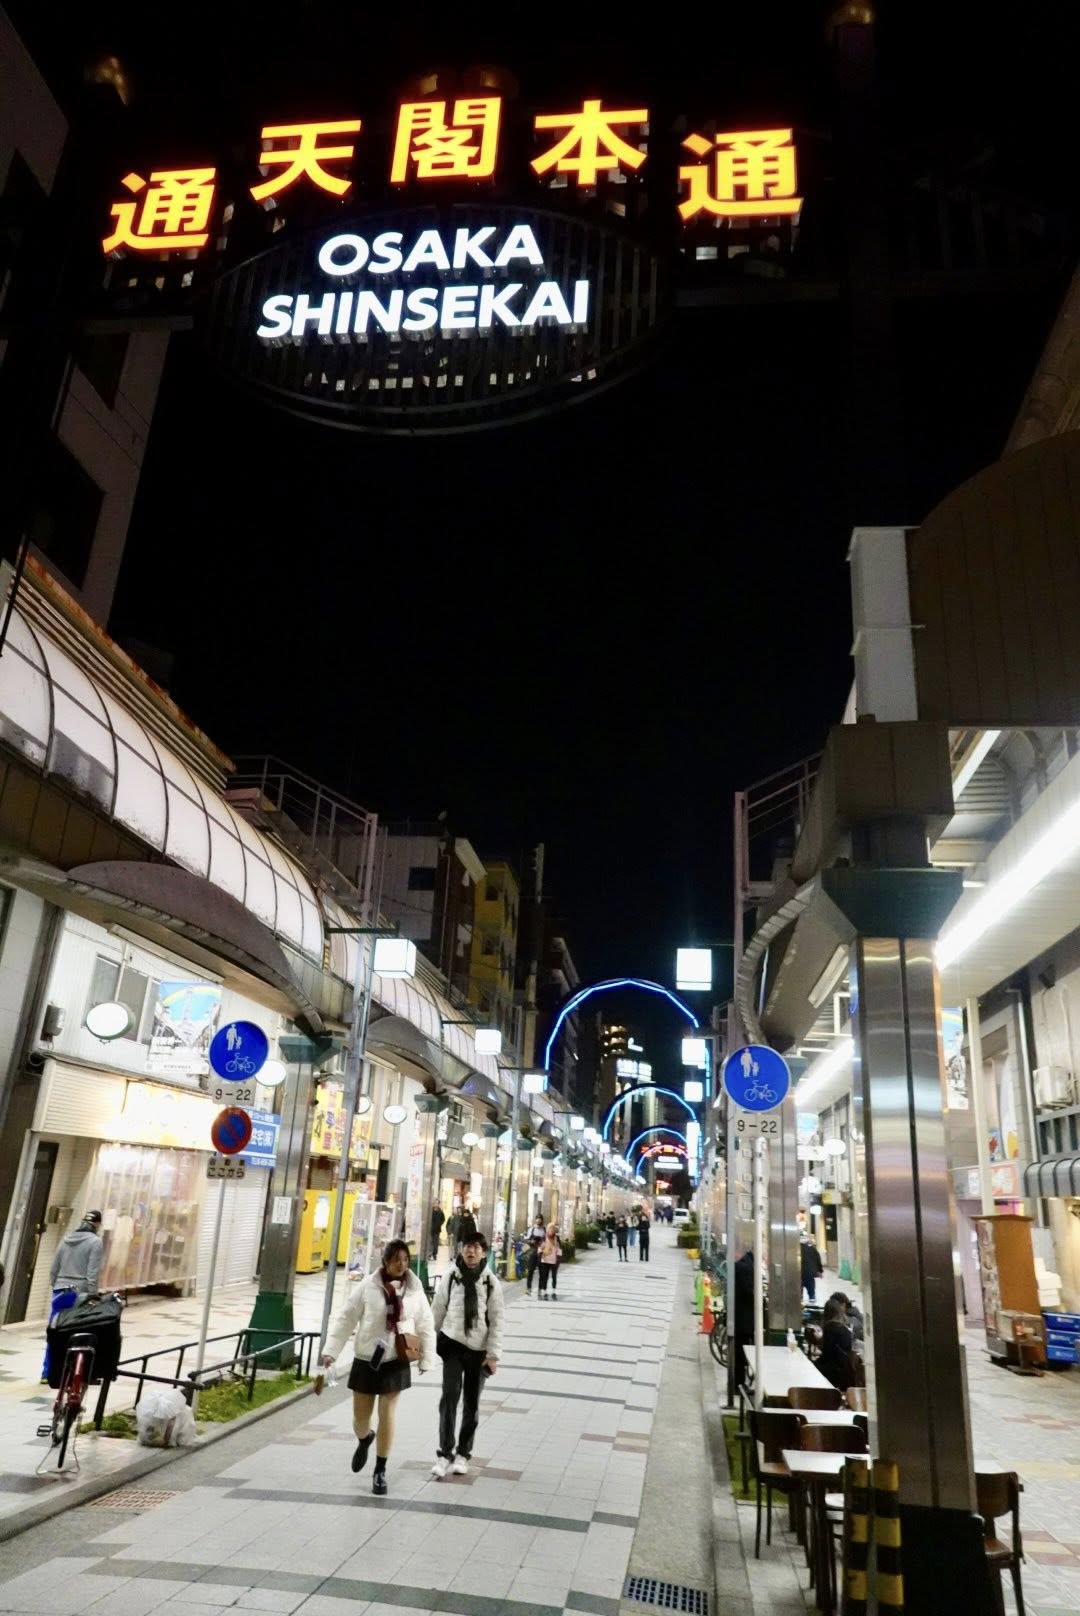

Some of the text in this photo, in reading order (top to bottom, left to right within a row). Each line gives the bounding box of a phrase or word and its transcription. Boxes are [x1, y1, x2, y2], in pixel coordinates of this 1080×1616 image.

[101, 97, 802, 253] 通天閣本通
[318, 223, 544, 276] OSAKA
[256, 280, 589, 338] SHINSEKAI
[737, 1119, 777, 1134] 9-22
[207, 1167, 245, 1178] ここから
